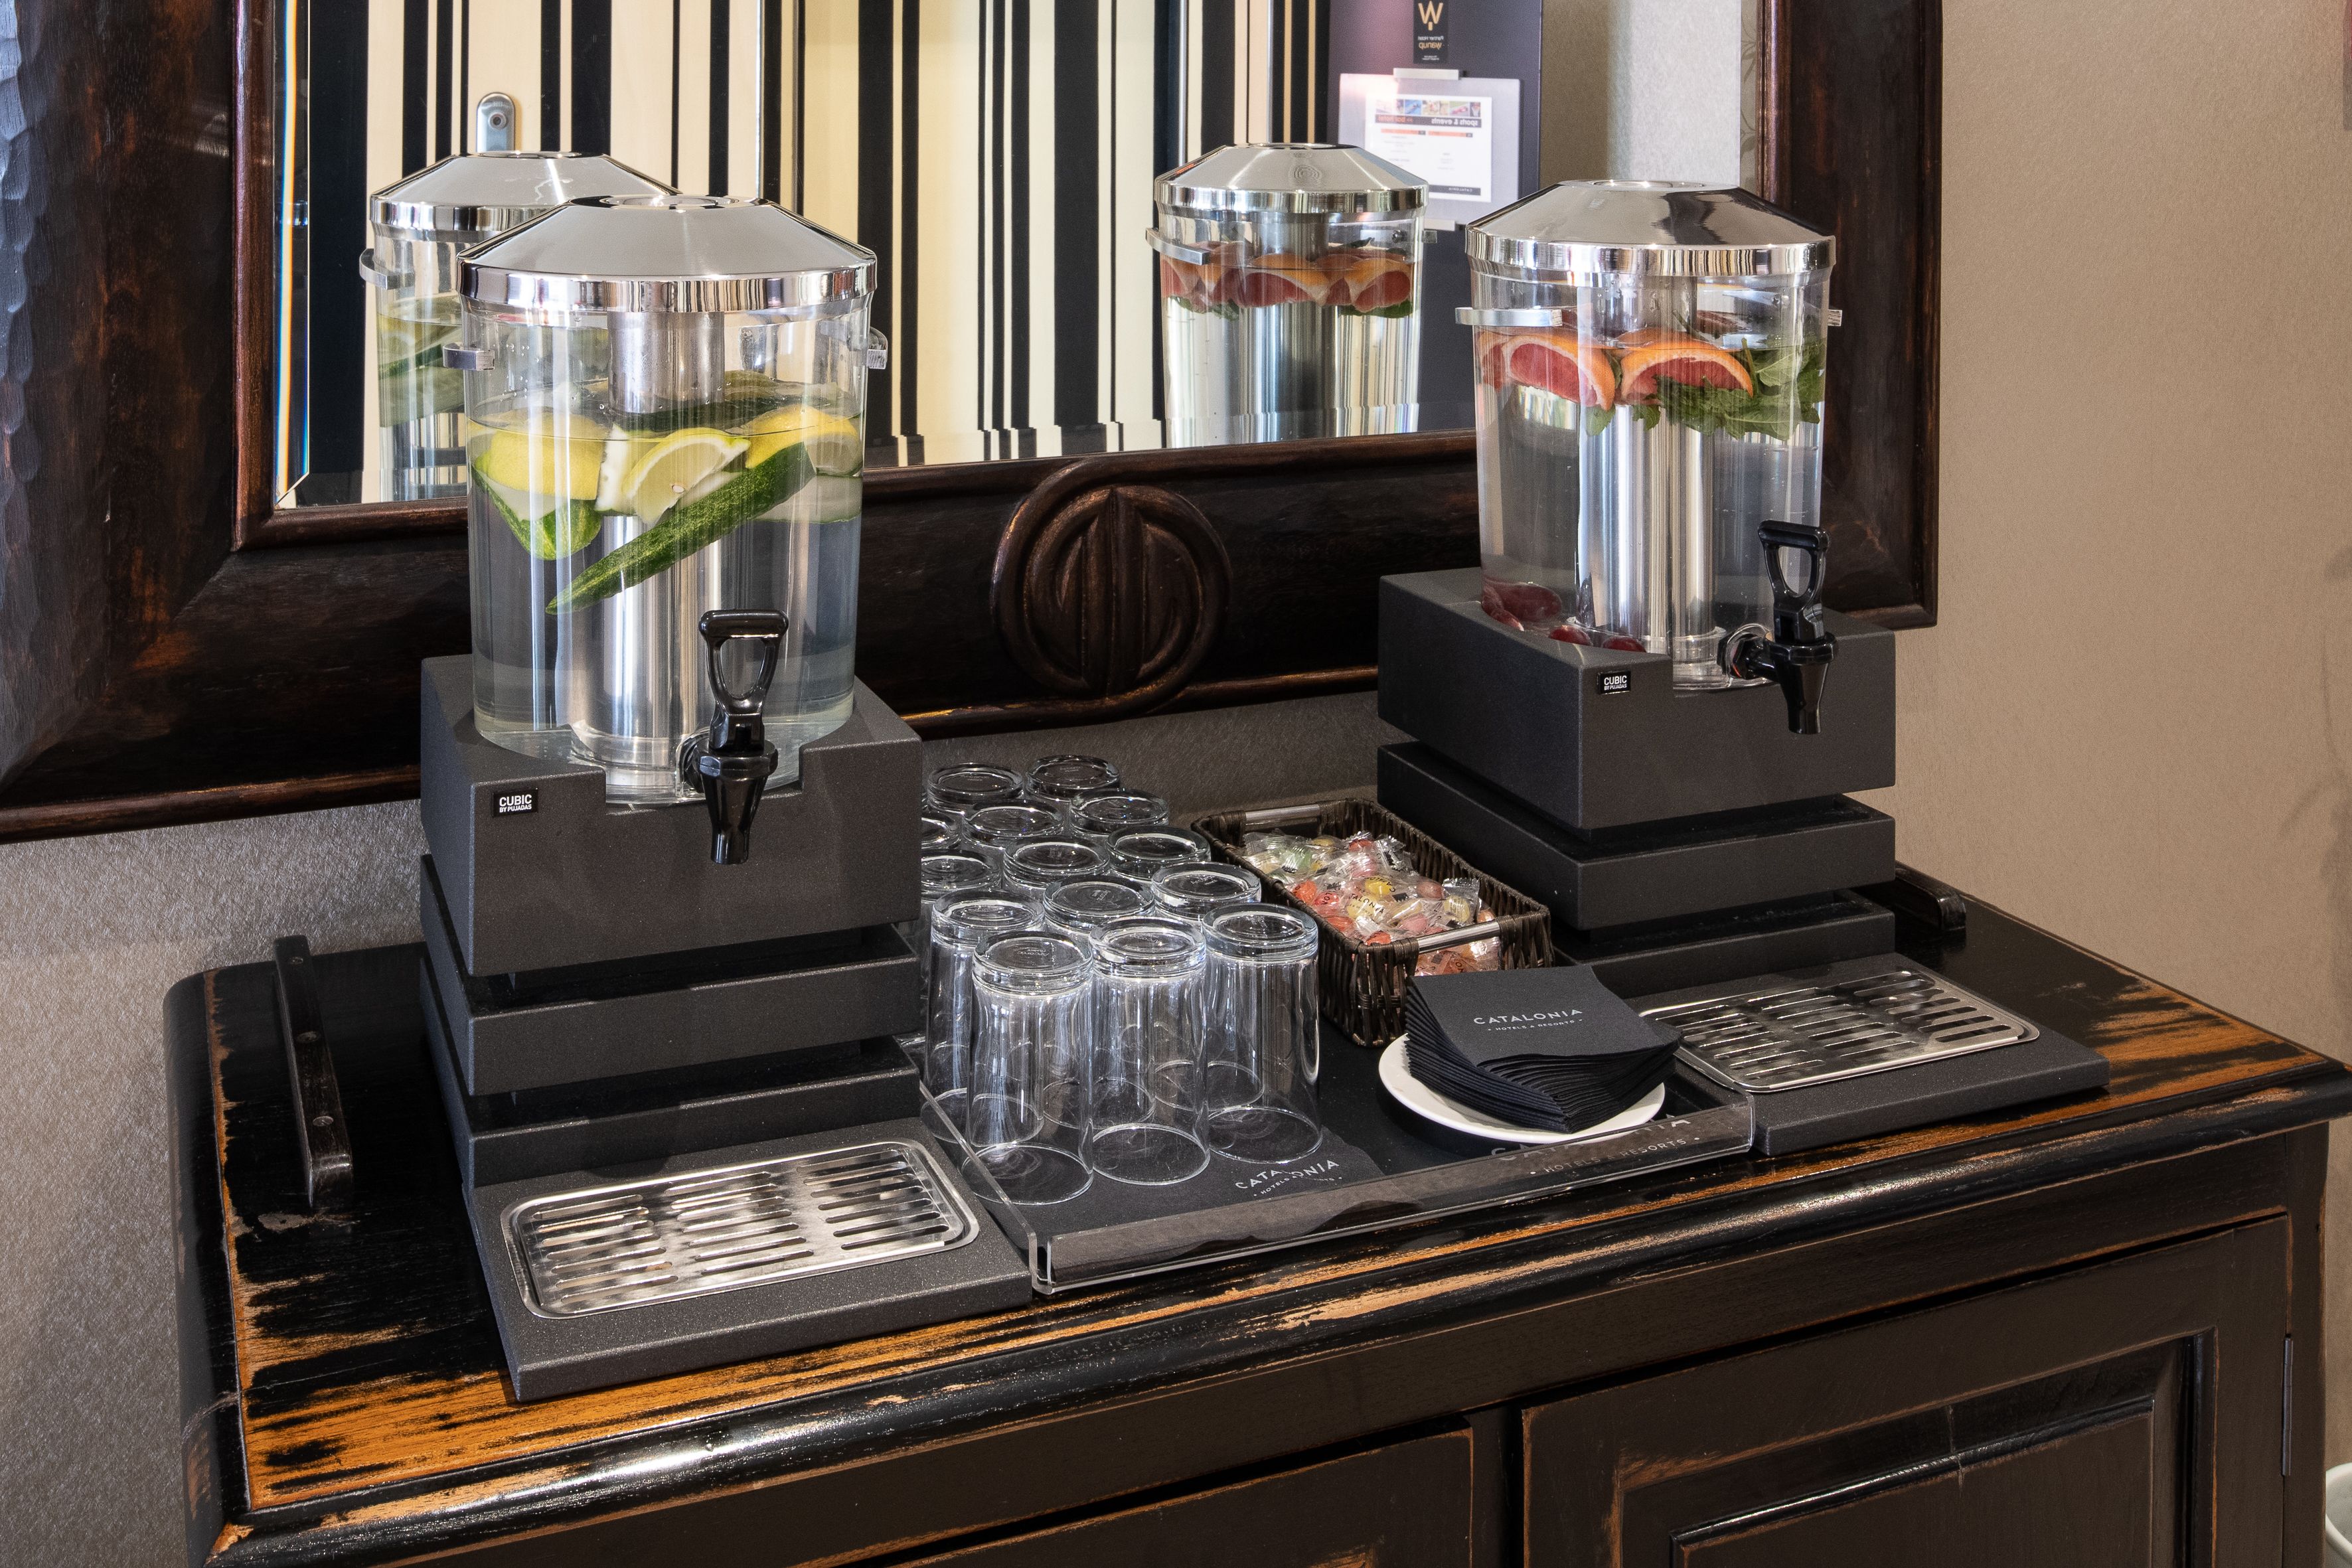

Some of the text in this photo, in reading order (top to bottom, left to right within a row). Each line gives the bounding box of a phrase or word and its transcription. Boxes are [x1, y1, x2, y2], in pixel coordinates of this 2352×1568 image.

[1604, 675, 1627, 686] CUBIC
[499, 794, 532, 807] CUBIC
[1473, 1008, 1583, 1024] CATALONIA
[1543, 1155, 1601, 1172] HOTELS
[1620, 1138, 1687, 1158] RESORTS
[1260, 1177, 1291, 1194] HOTELS
